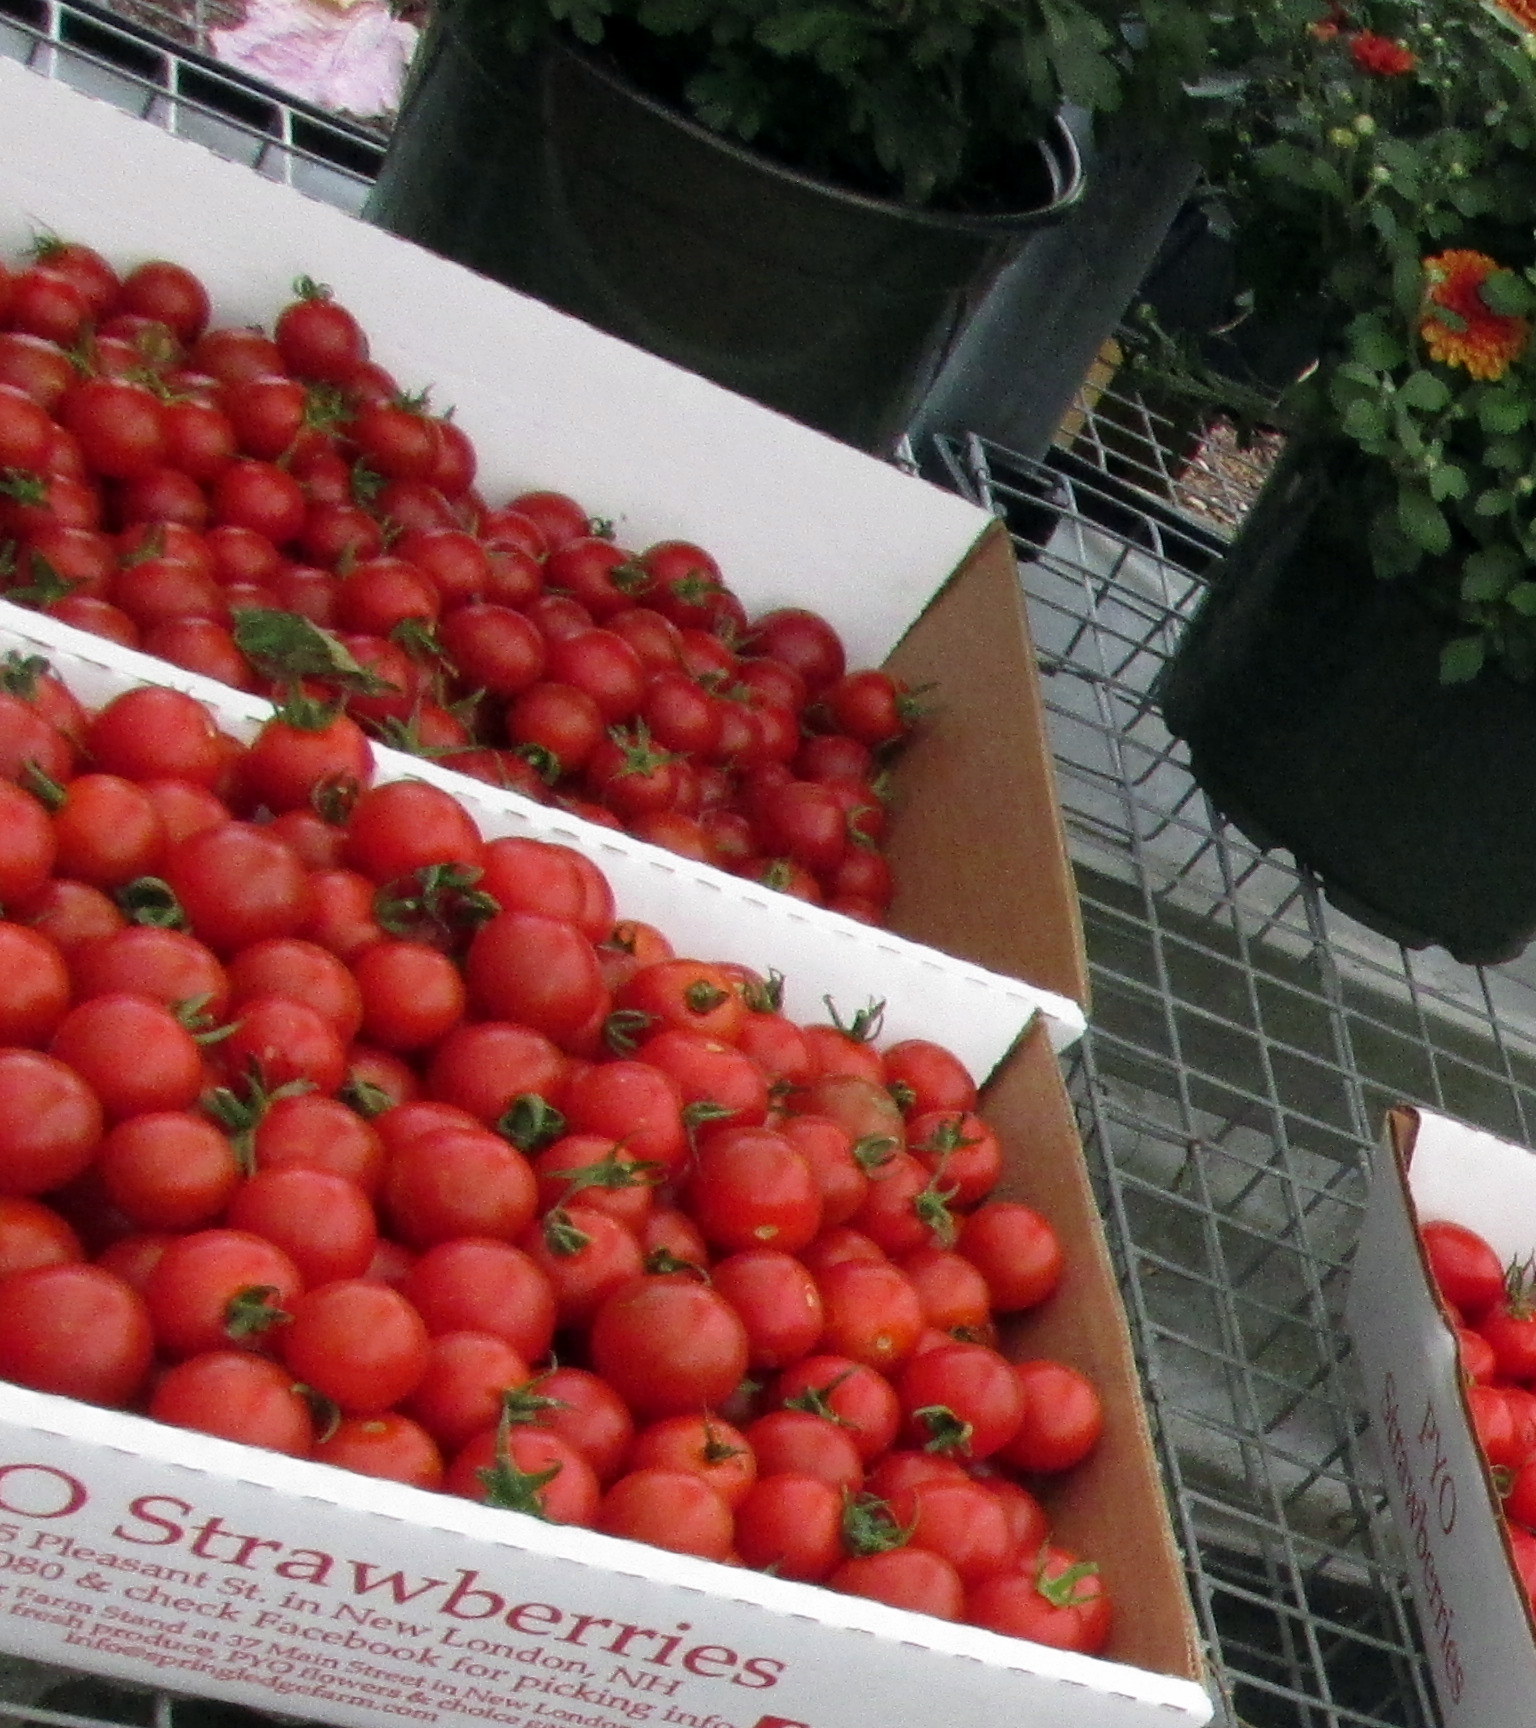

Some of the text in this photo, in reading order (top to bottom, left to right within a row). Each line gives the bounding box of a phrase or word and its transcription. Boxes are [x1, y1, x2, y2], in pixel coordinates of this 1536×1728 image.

[18, 1588, 95, 1614] Farm
[107, 1607, 189, 1636] Stand
[196, 1630, 223, 1644] at
[233, 1635, 261, 1655] 37
[269, 1643, 340, 1669] Main
[352, 1662, 428, 1693] Street
[430, 1681, 460, 1695] in
[461, 1686, 529, 1709] New
[31, 1532, 212, 1588] Pleasant
[219, 1578, 264, 1602] St.
[281, 1593, 324, 1615] in
[331, 1603, 432, 1637] New
[441, 1627, 595, 1677] London,
[610, 1667, 685, 1696] NH
[75, 1572, 113, 1592] &
[124, 1584, 243, 1622] check
[254, 1611, 443, 1667] Facebook
[450, 1656, 509, 1680] for
[511, 1675, 660, 1720] picking
[112, 1495, 789, 1690] Strawberries
[229, 1649, 298, 1676] PYO
[298, 1662, 405, 1698] flowers
[409, 1691, 430, 1704] &
[436, 1697, 522, 1725] choice
